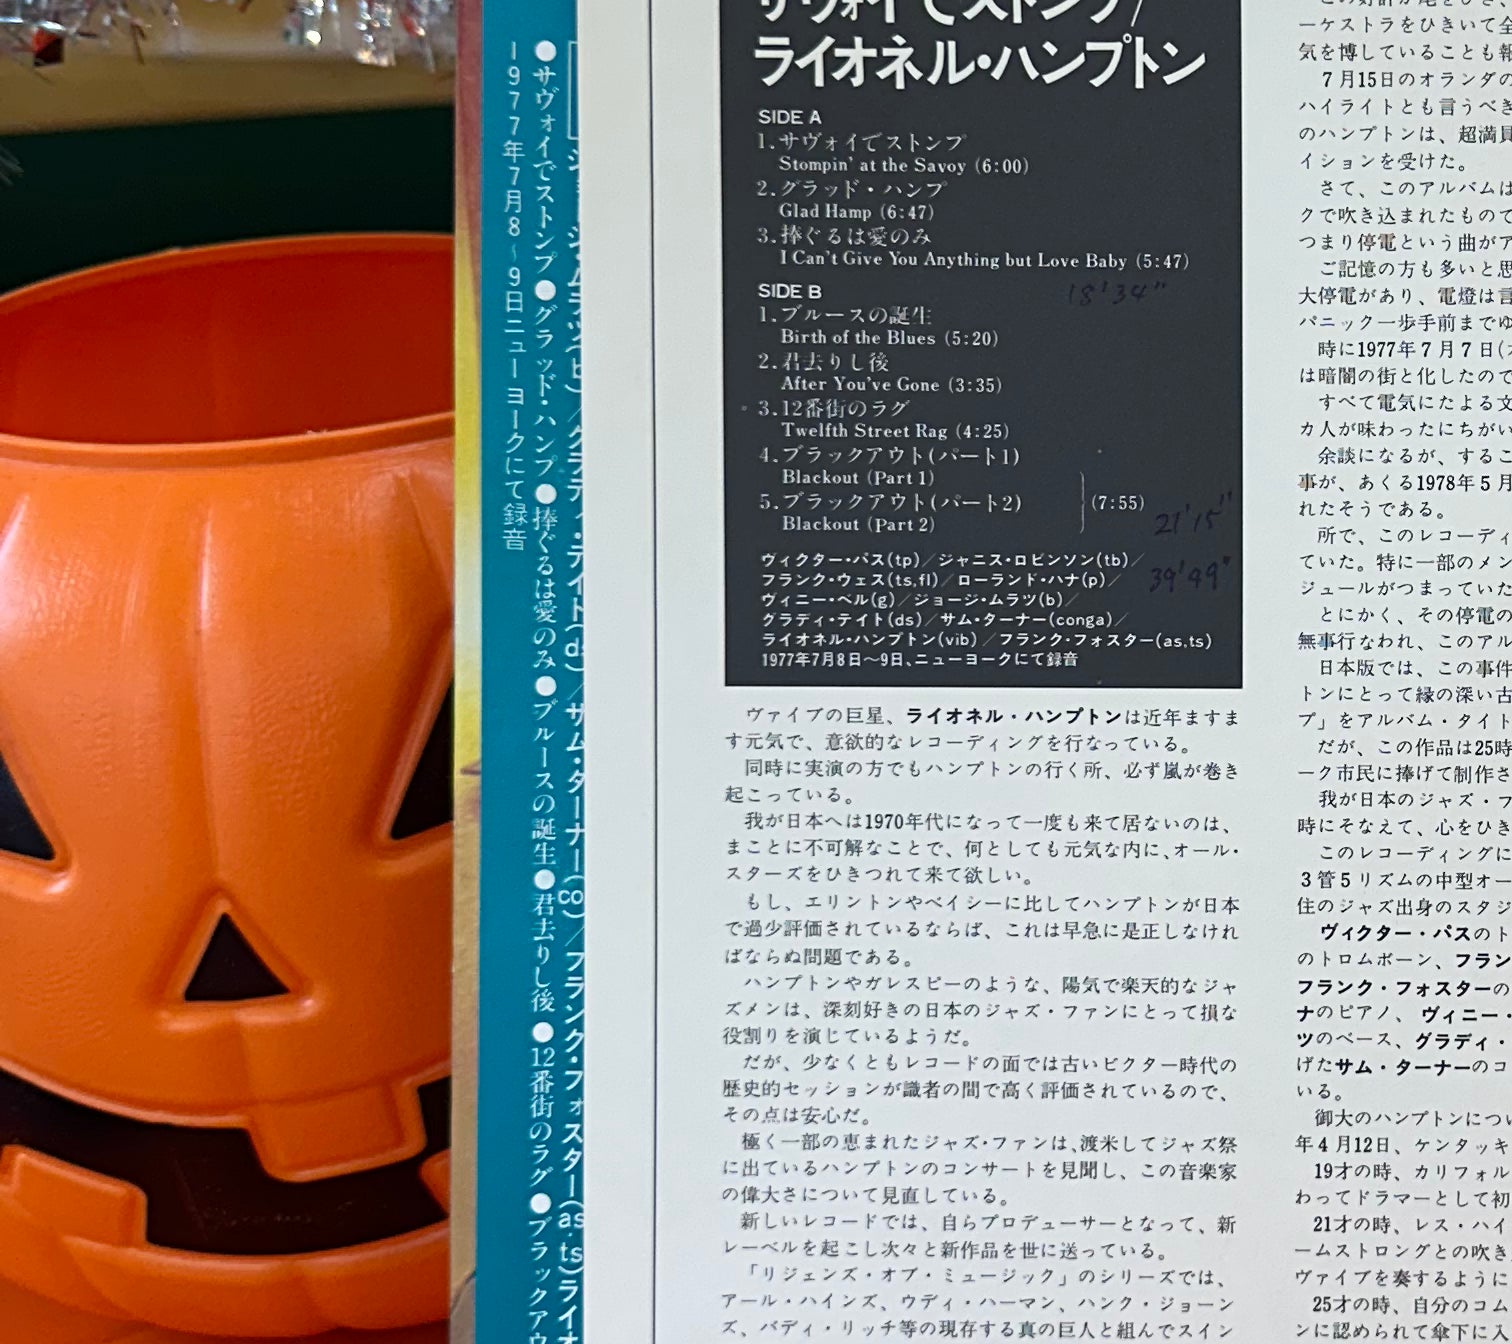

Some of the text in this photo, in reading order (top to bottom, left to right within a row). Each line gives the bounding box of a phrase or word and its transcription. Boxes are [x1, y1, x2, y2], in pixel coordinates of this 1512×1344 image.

[753, 33, 1205, 89] ライオネル・ハンプトン
[758, 109, 822, 124] SIDE A
[860, 160, 876, 172] at
[882, 156, 908, 172] the
[914, 157, 966, 175] Savoy
[975, 158, 1028, 175] (6:00)
[779, 202, 934, 222] Glad Hamp (6:47)
[781, 250, 1189, 271] I Can't Give You Anything but Love Baby (5:47)
[758, 283, 822, 299] SIDE B
[781, 328, 998, 347] Birth of the Blues (5:20)
[781, 376, 1001, 394] After You've Gone (3:35)
[781, 422, 1008, 441] Twelfth Street Rag (4:25)
[783, 469, 859, 484] Blackout
[867, 469, 913, 486] (Part
[1092, 495, 1144, 511] (7:55)
[1299, 500, 1443, 519] れたそうである。
[783, 516, 934, 533] Blackout (Part 2)
[725, 785, 852, 805] 起こっている。
[1297, 1083, 1341, 1102] いる。
[724, 1106, 868, 1126] その点は安心だ。
